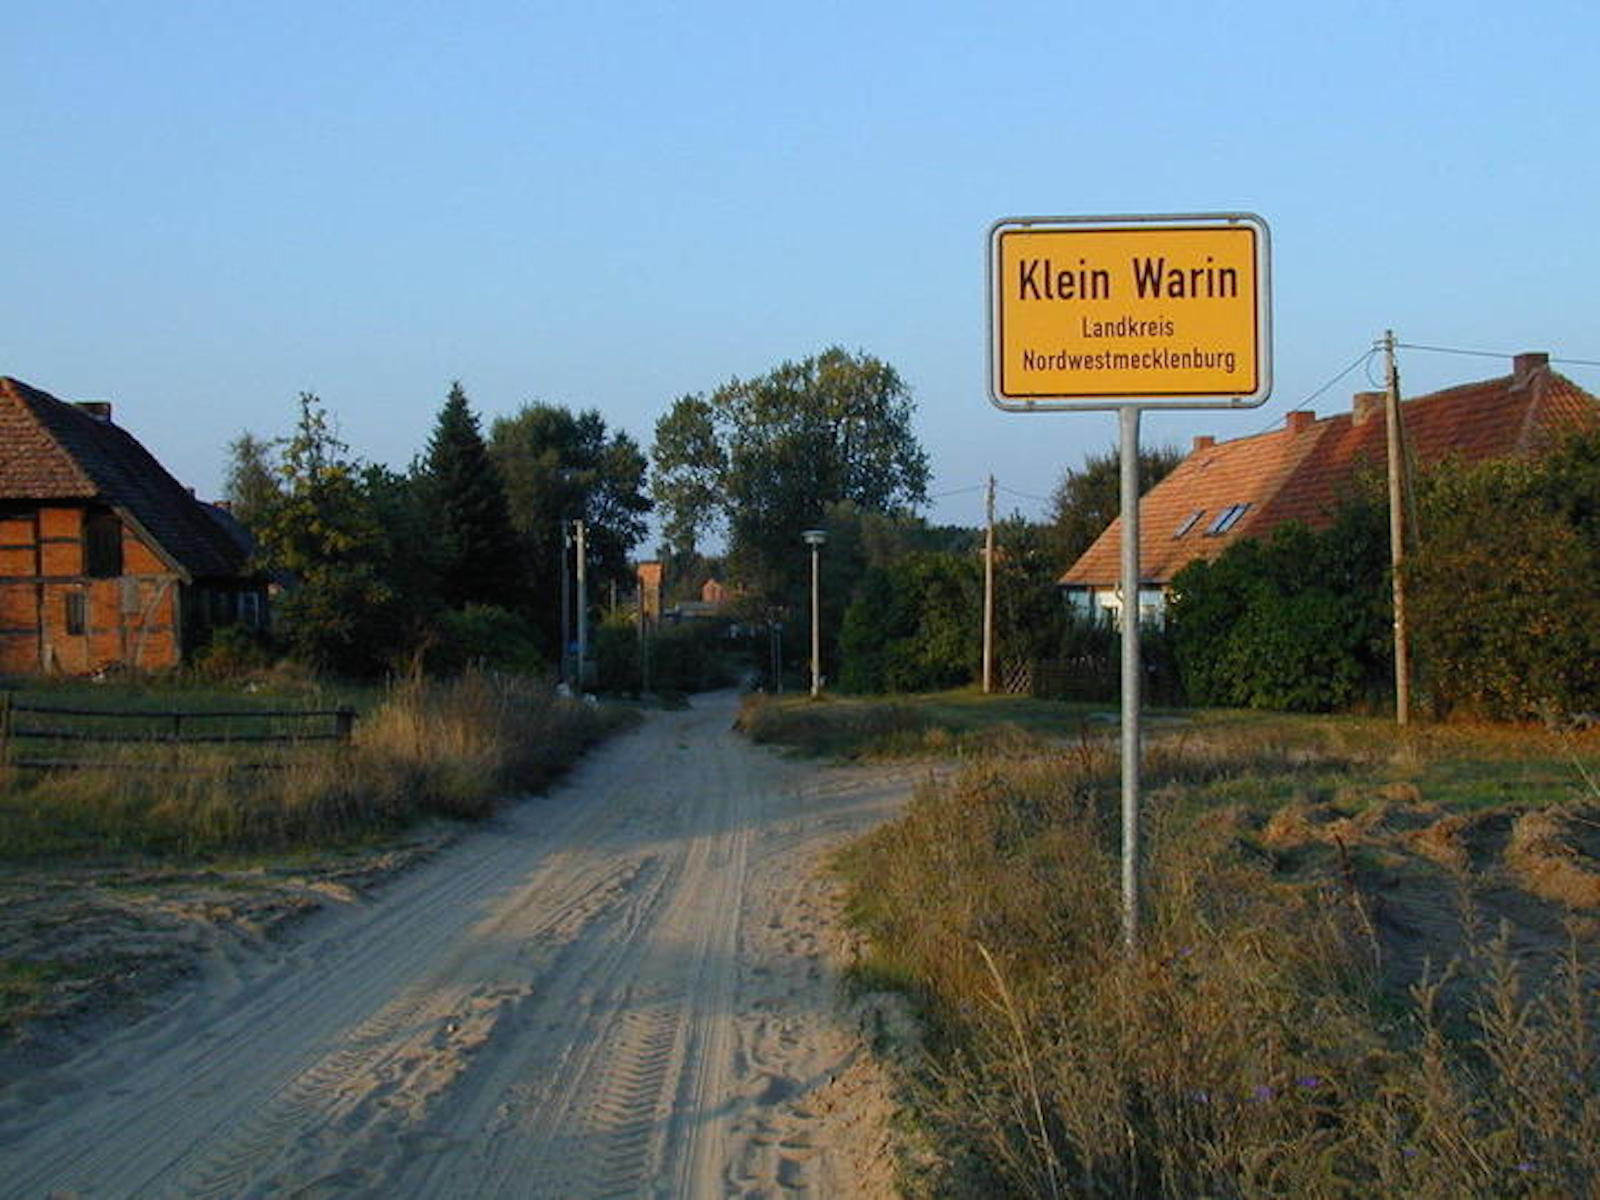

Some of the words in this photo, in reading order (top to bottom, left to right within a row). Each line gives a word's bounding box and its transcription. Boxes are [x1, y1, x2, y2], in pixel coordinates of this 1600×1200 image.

[1019, 258, 1110, 300] Klein
[1132, 256, 1238, 298] Warin
[1082, 315, 1174, 338] Landkreis
[1023, 348, 1236, 373] Nordwestmecklenburg
